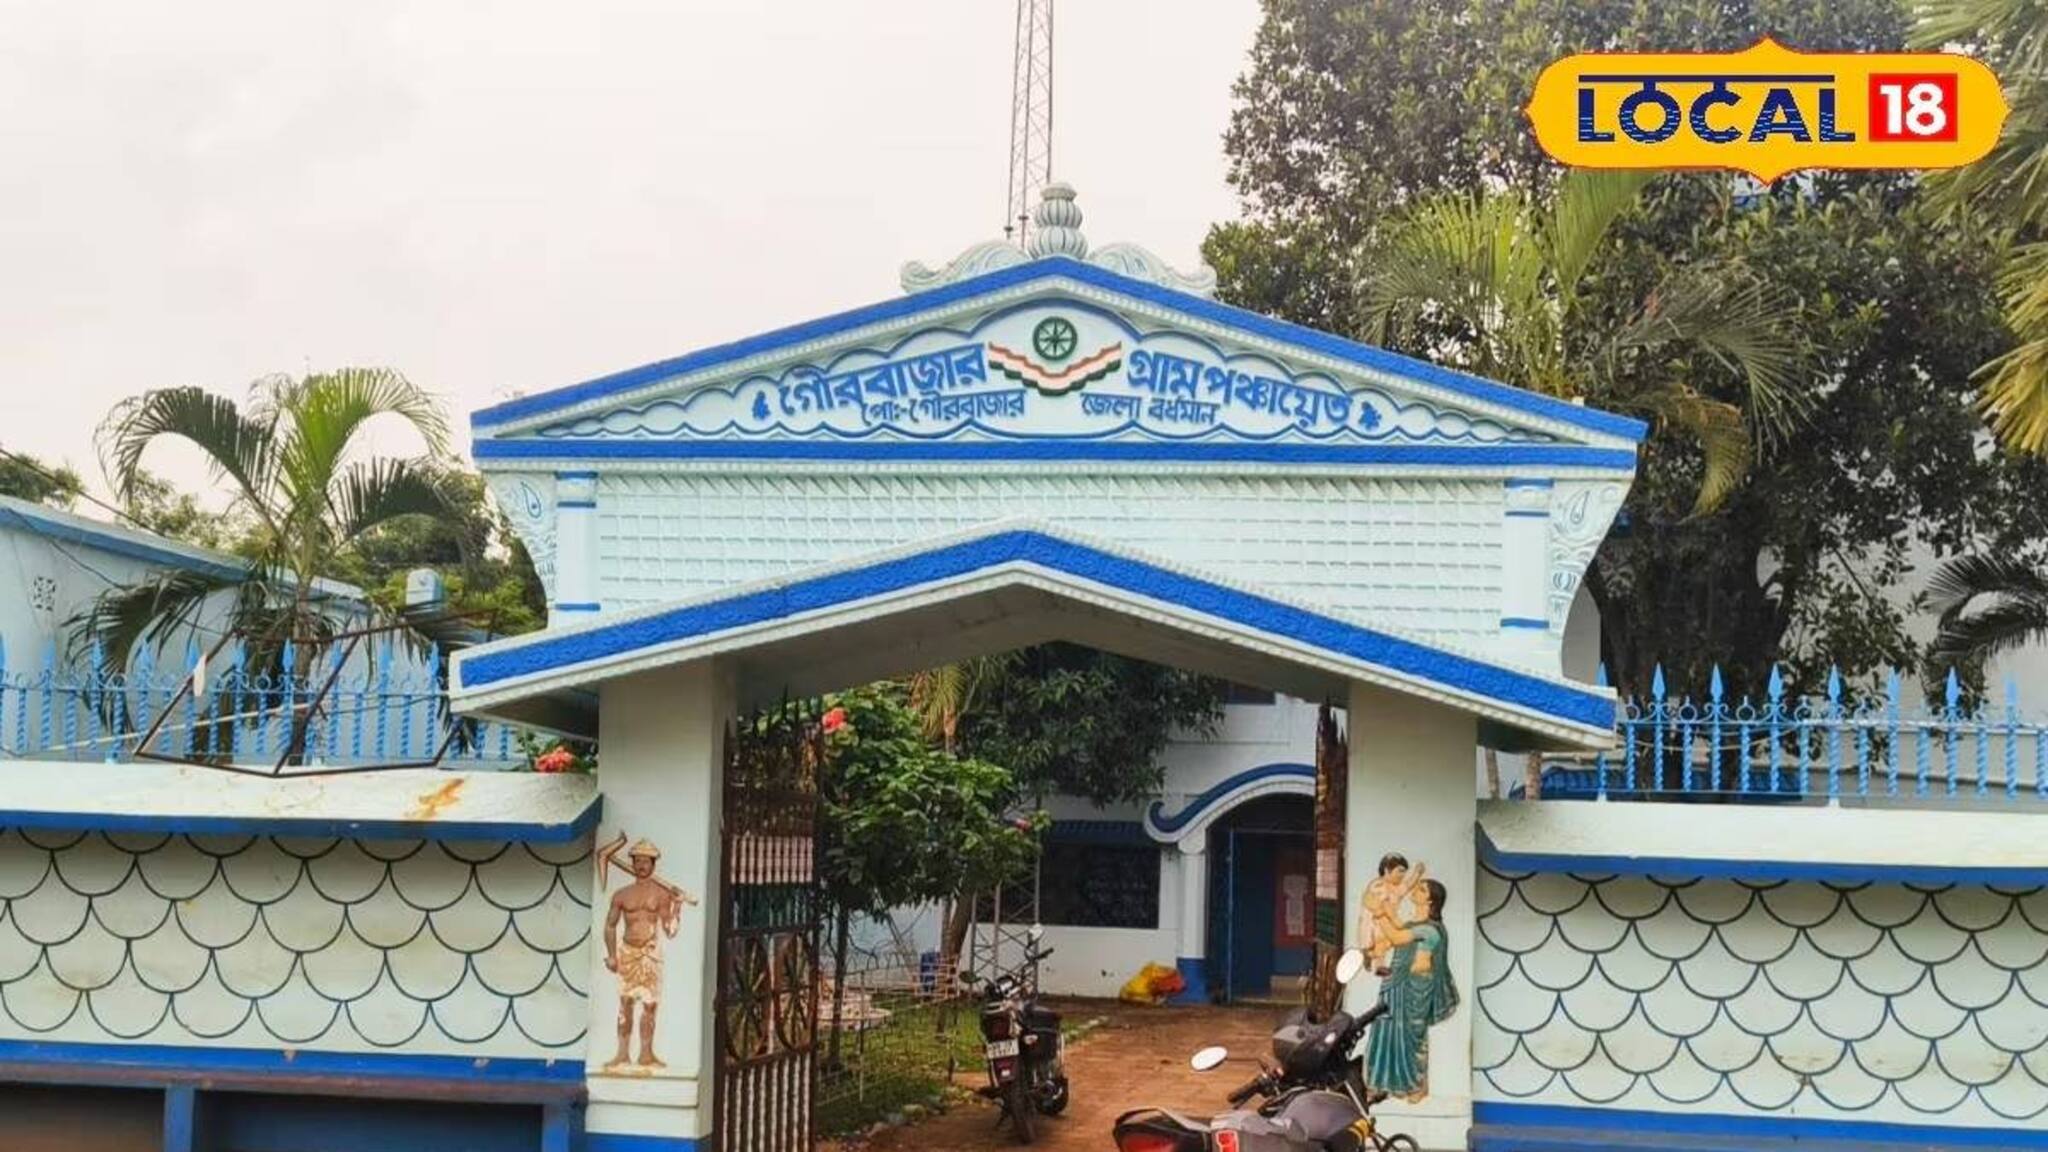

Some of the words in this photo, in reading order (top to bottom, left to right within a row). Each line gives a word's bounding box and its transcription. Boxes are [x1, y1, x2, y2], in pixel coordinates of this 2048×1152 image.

[778, 342, 988, 416] গৌরবাজার
[1080, 392, 1142, 419] জেলা
[1148, 395, 1220, 425] বর্ধমান
